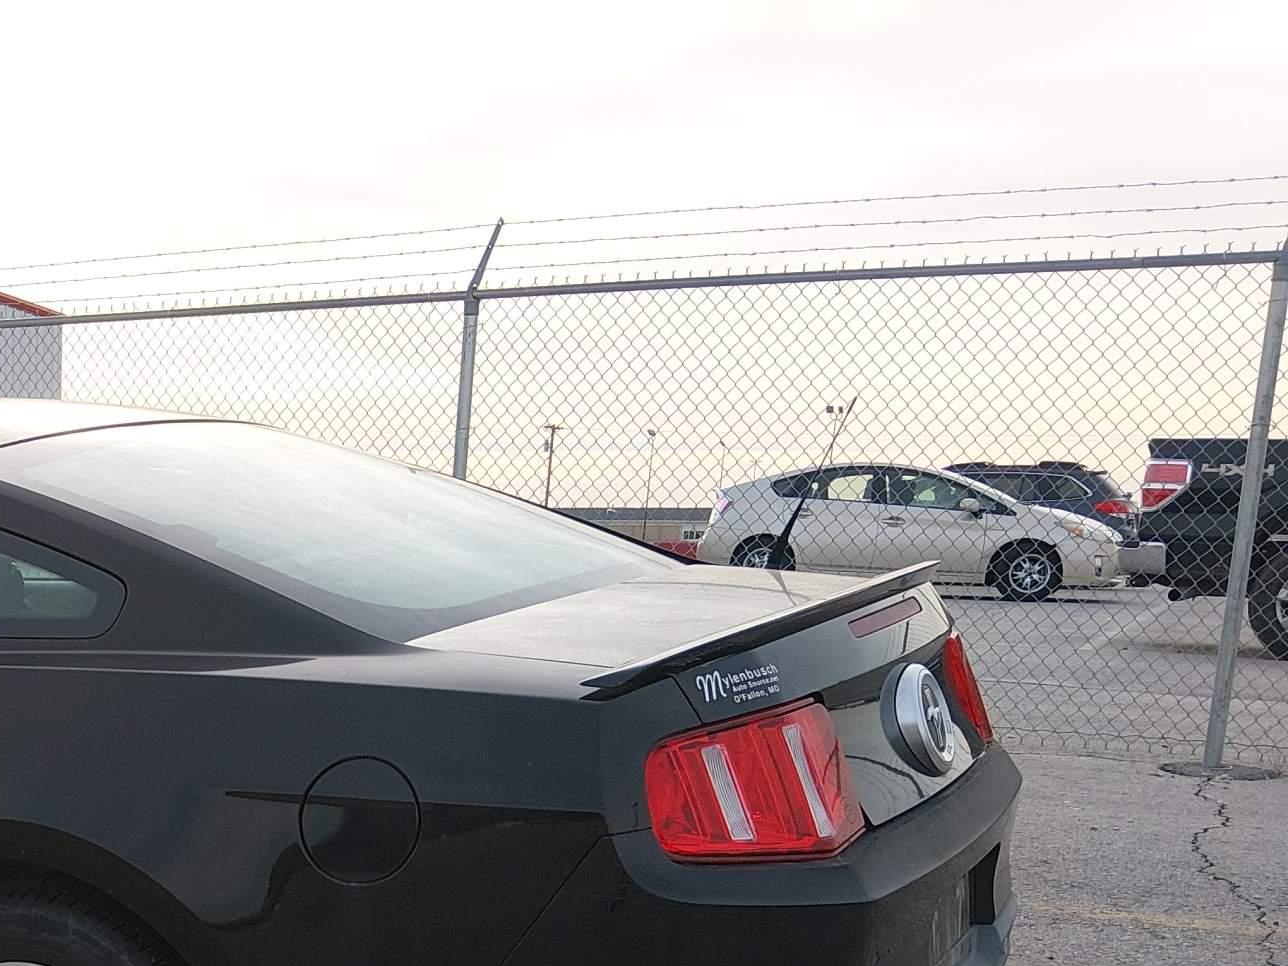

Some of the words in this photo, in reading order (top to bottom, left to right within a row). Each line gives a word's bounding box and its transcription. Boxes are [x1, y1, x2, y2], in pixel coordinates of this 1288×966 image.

[696, 664, 778, 703] Mylenbusch
[732, 684, 748, 692] Auto
[768, 685, 780, 693] MO
